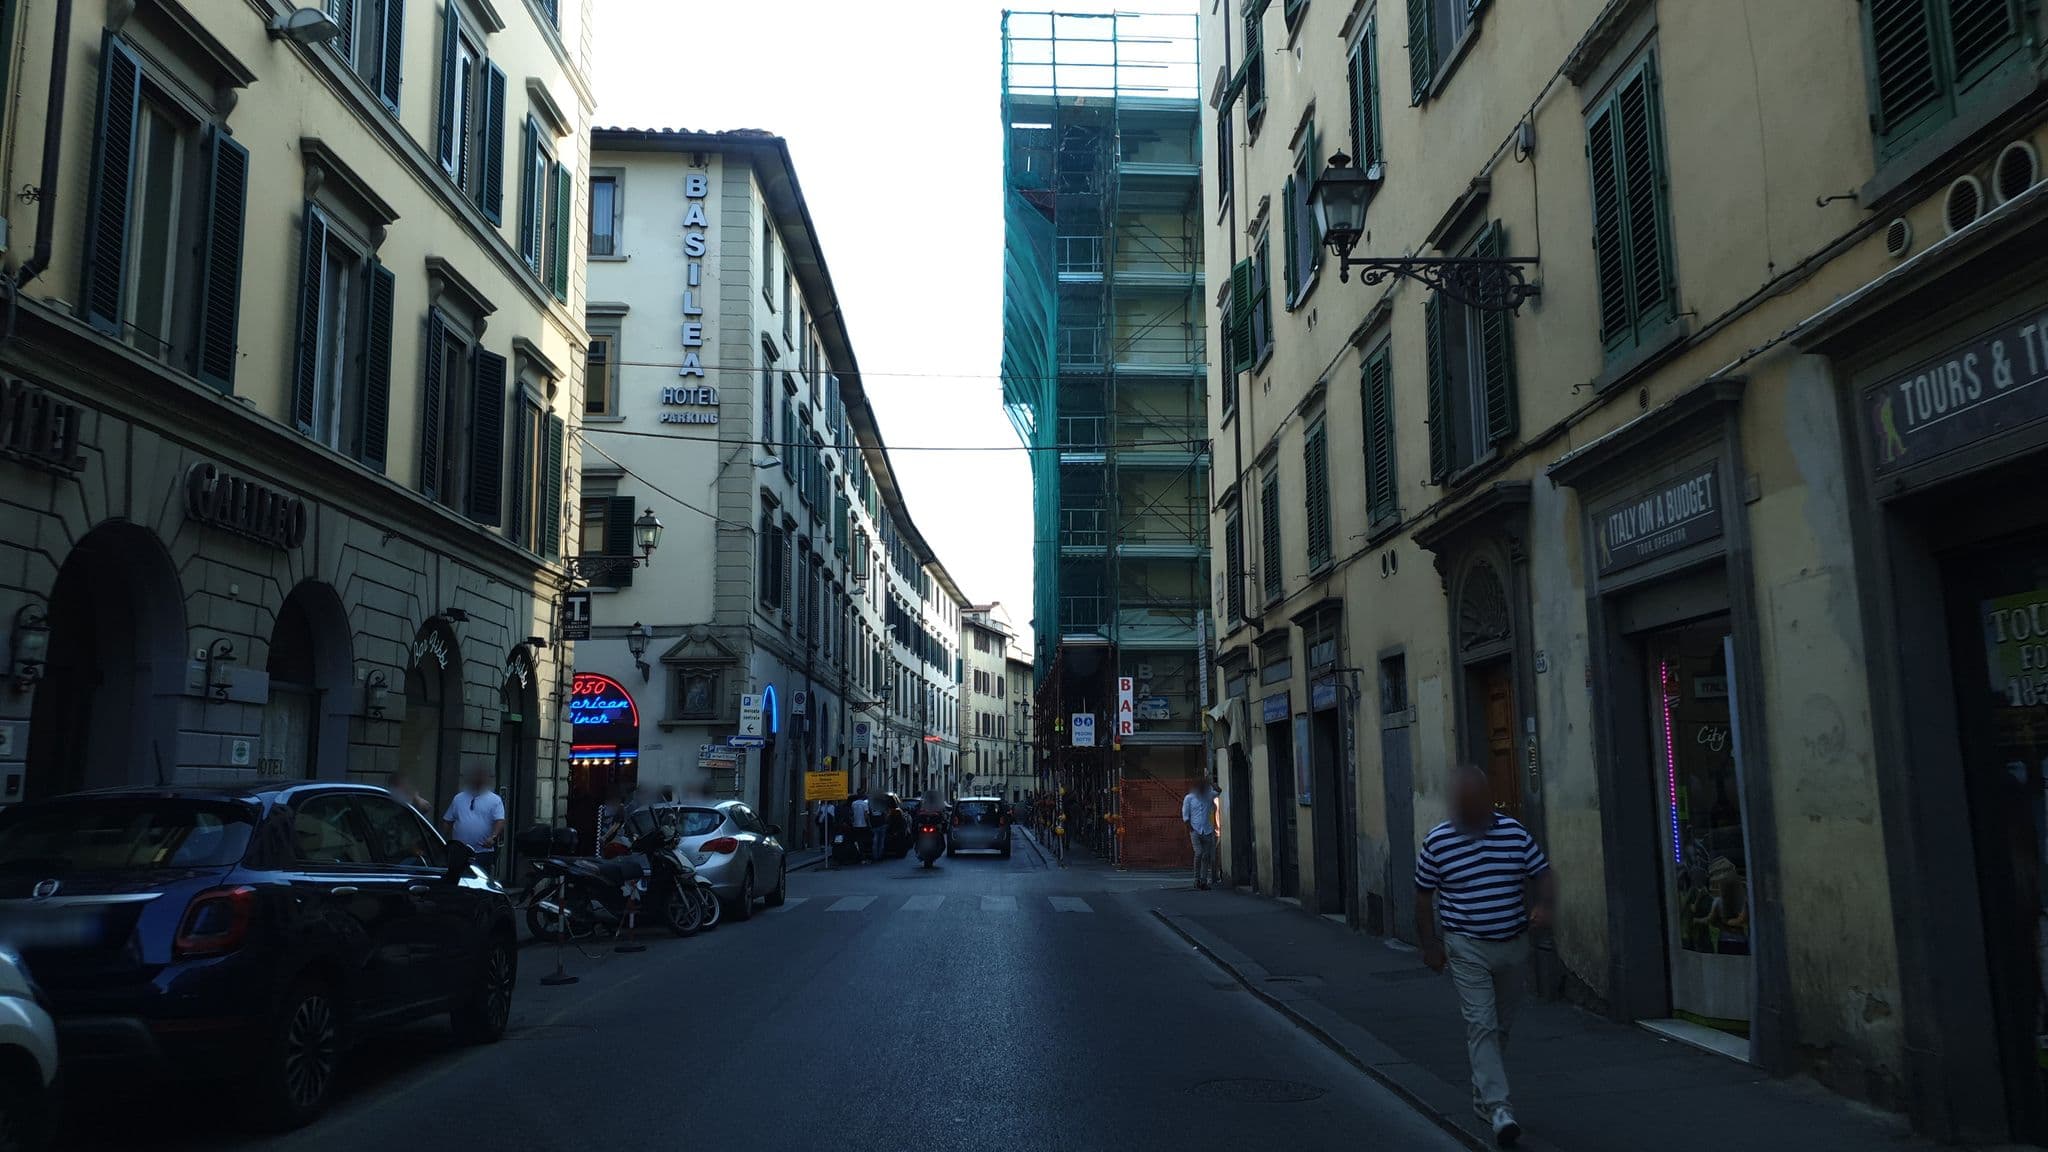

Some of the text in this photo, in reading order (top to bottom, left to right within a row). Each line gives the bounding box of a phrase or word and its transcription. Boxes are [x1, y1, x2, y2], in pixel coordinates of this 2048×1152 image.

[679, 174, 708, 377] BASILEA
[1900, 352, 1982, 425] TOURS
[1992, 340, 2013, 389] &
[662, 387, 720, 406] HOTEL
[660, 412, 719, 424] PARKING
[1608, 472, 1712, 546] ITALY ON A BUDGET
[572, 681, 606, 695] 950
[570, 696, 629, 709] erican
[1121, 679, 1132, 734] BAR
[1697, 725, 1728, 752] City
